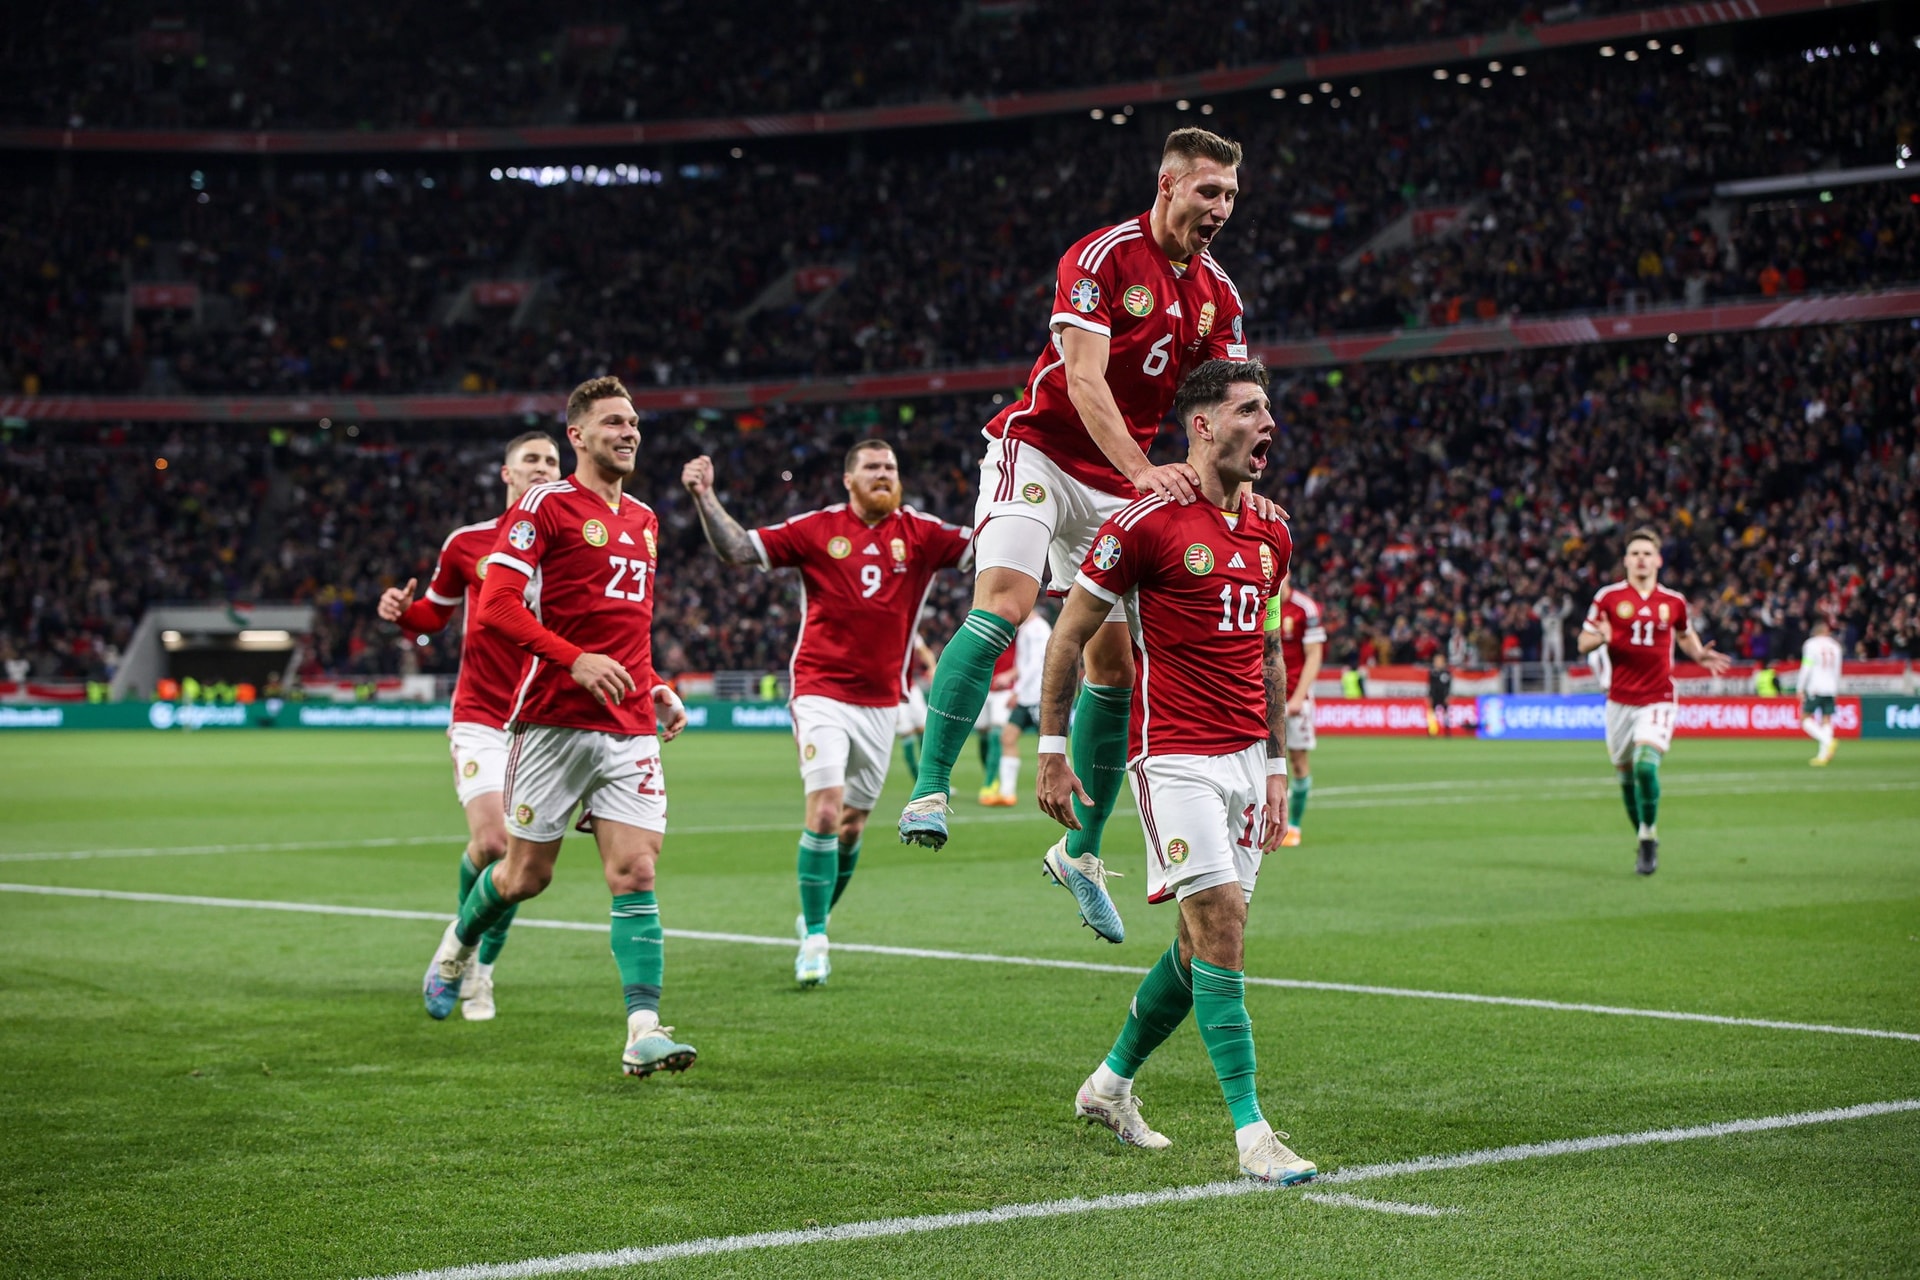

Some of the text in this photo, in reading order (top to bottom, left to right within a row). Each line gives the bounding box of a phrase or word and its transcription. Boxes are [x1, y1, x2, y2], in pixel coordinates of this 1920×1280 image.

[1142, 333, 1173, 377] 6
[604, 555, 648, 602] 23
[861, 564, 882, 599] 9
[1218, 584, 1260, 632] 10
[1630, 620, 1655, 647] 11
[1652, 709, 1671, 728] 11
